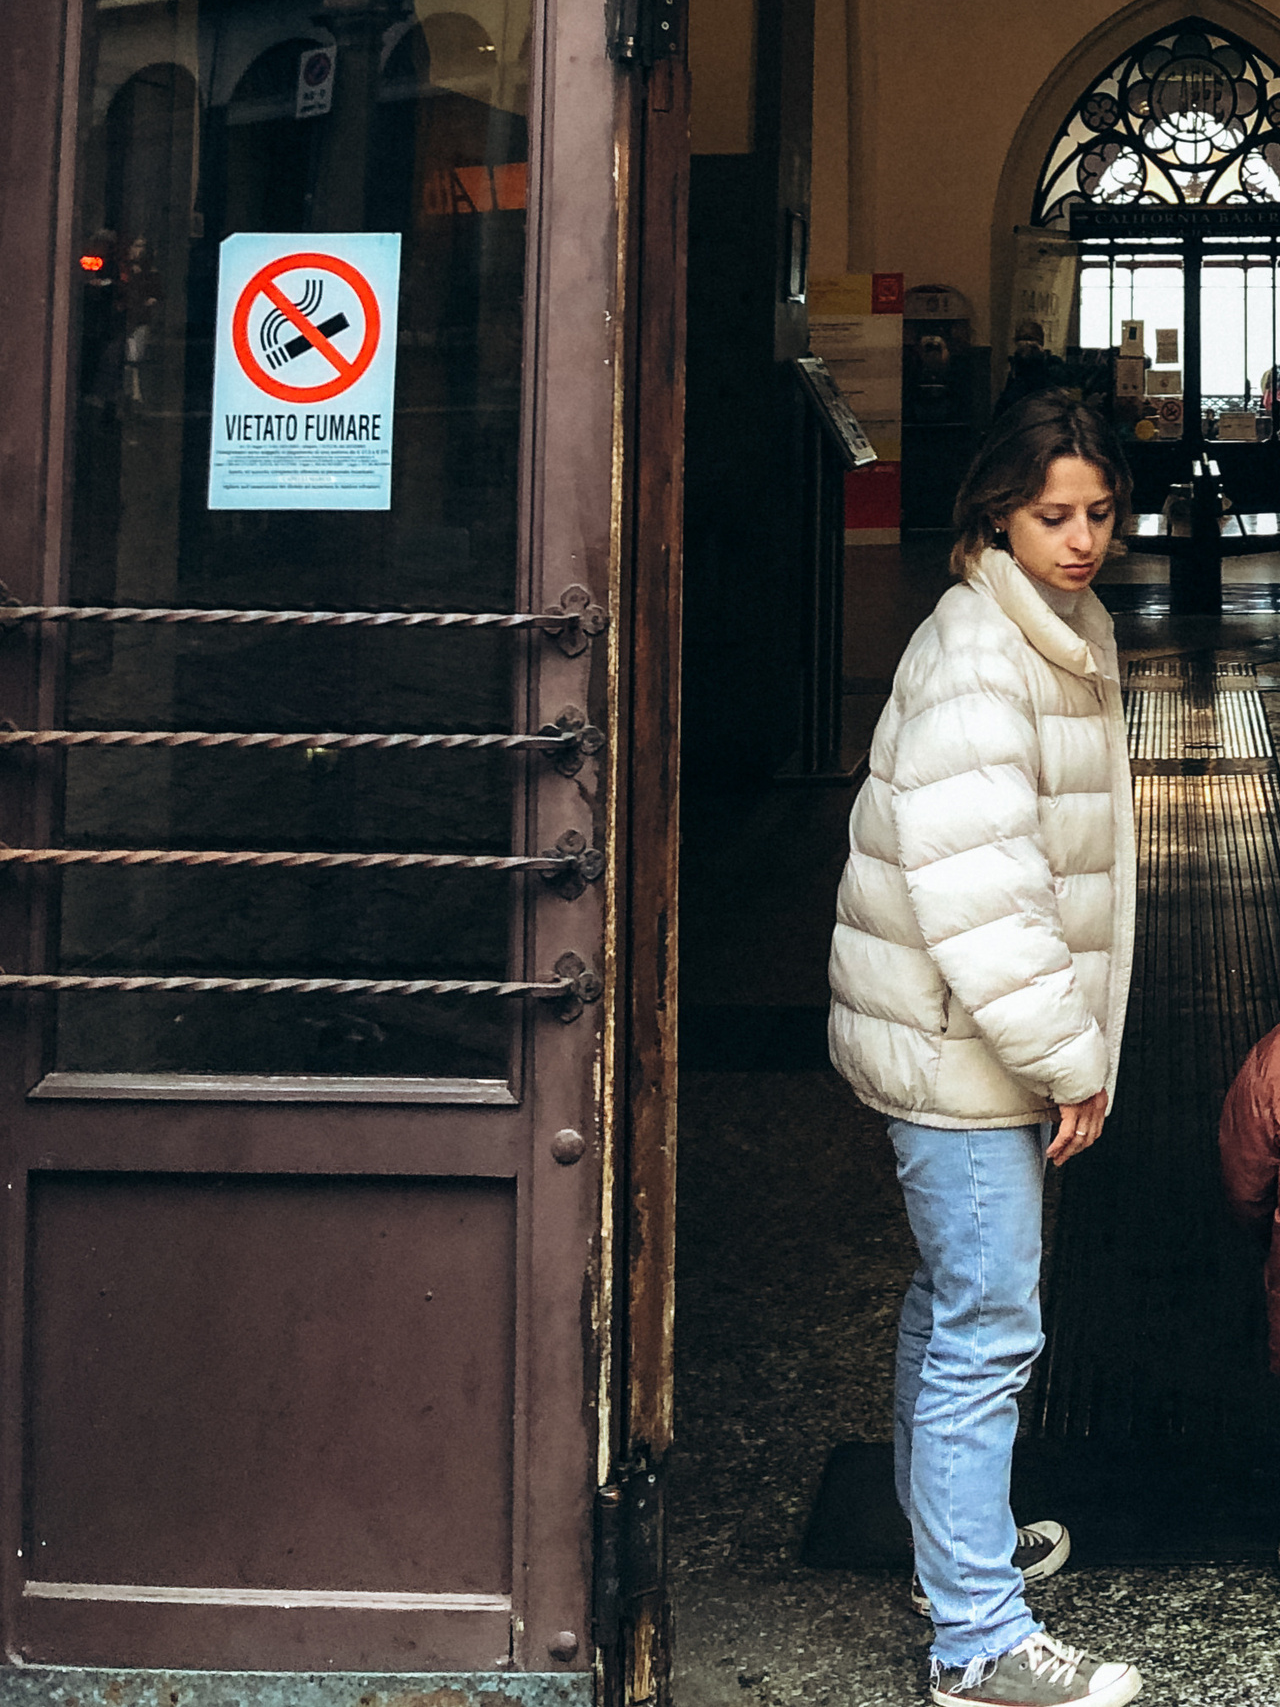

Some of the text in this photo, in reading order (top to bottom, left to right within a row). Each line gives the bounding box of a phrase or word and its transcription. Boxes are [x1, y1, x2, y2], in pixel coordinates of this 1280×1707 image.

[1094, 212, 1211, 225] CALIFORNIA
[225, 413, 382, 442] VIETATO FUMARE
